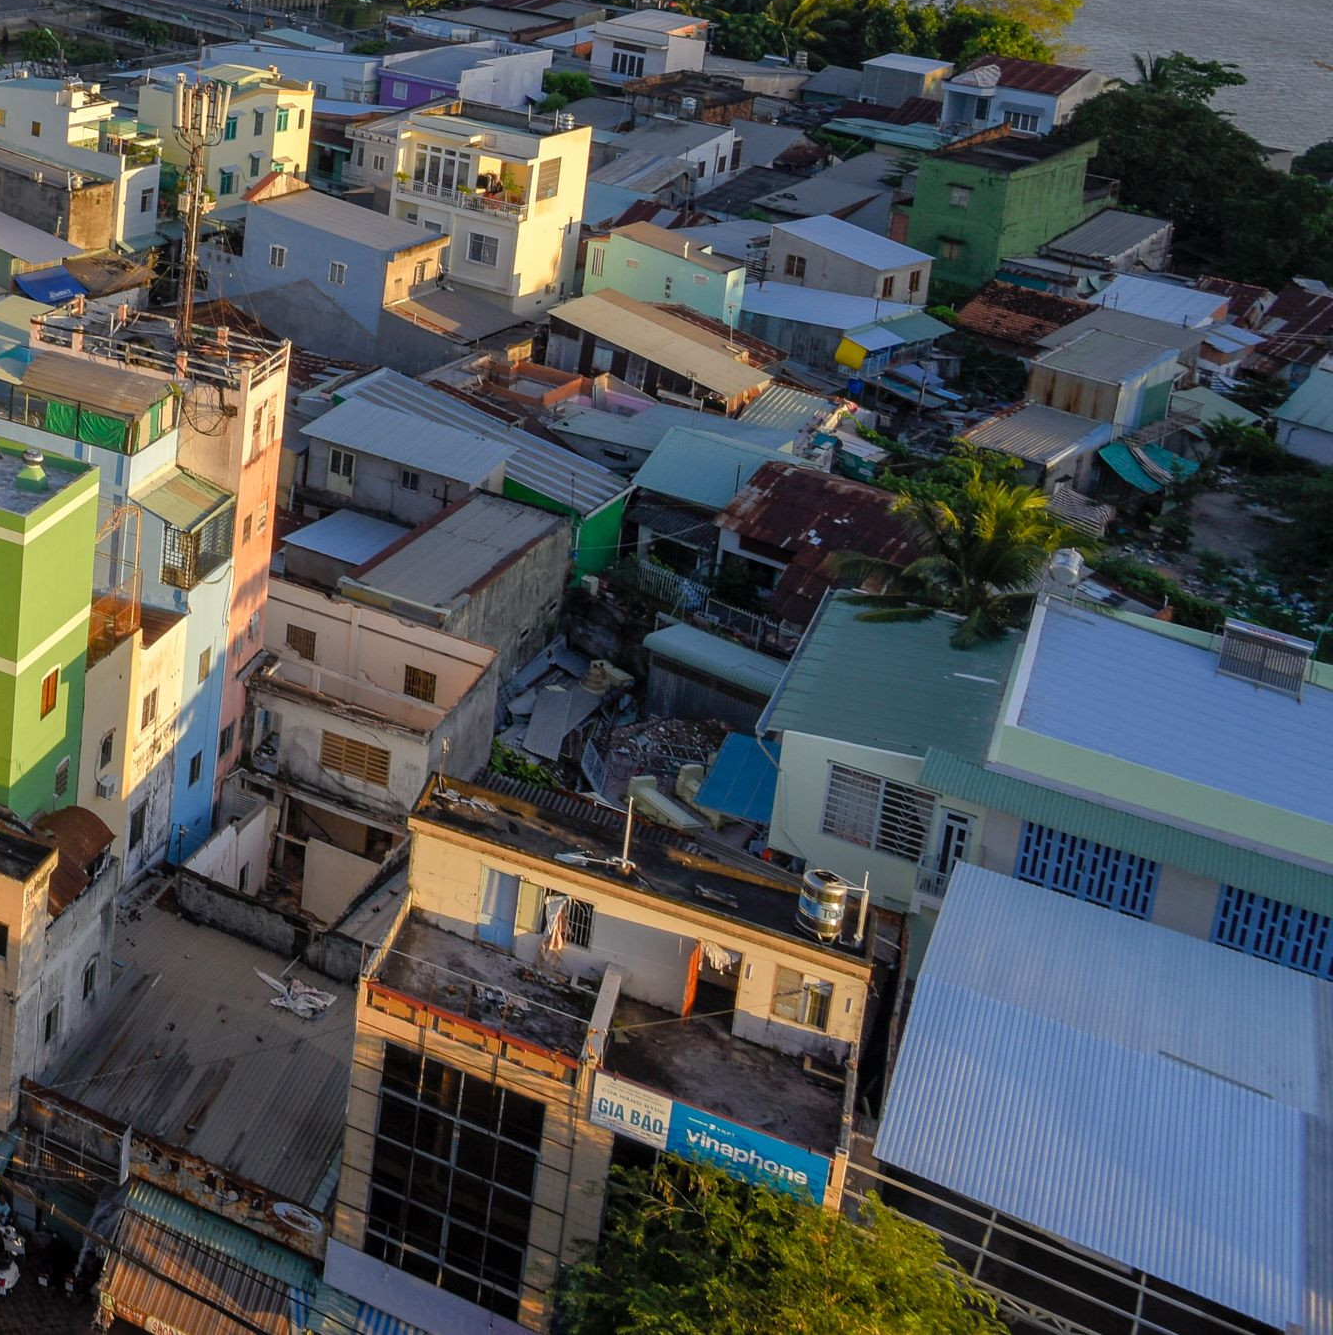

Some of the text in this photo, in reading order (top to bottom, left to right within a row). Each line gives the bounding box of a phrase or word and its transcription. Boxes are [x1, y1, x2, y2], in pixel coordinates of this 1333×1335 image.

[598, 1096, 664, 1135] GIA BẢO
[686, 1127, 808, 1186] vinaphone
